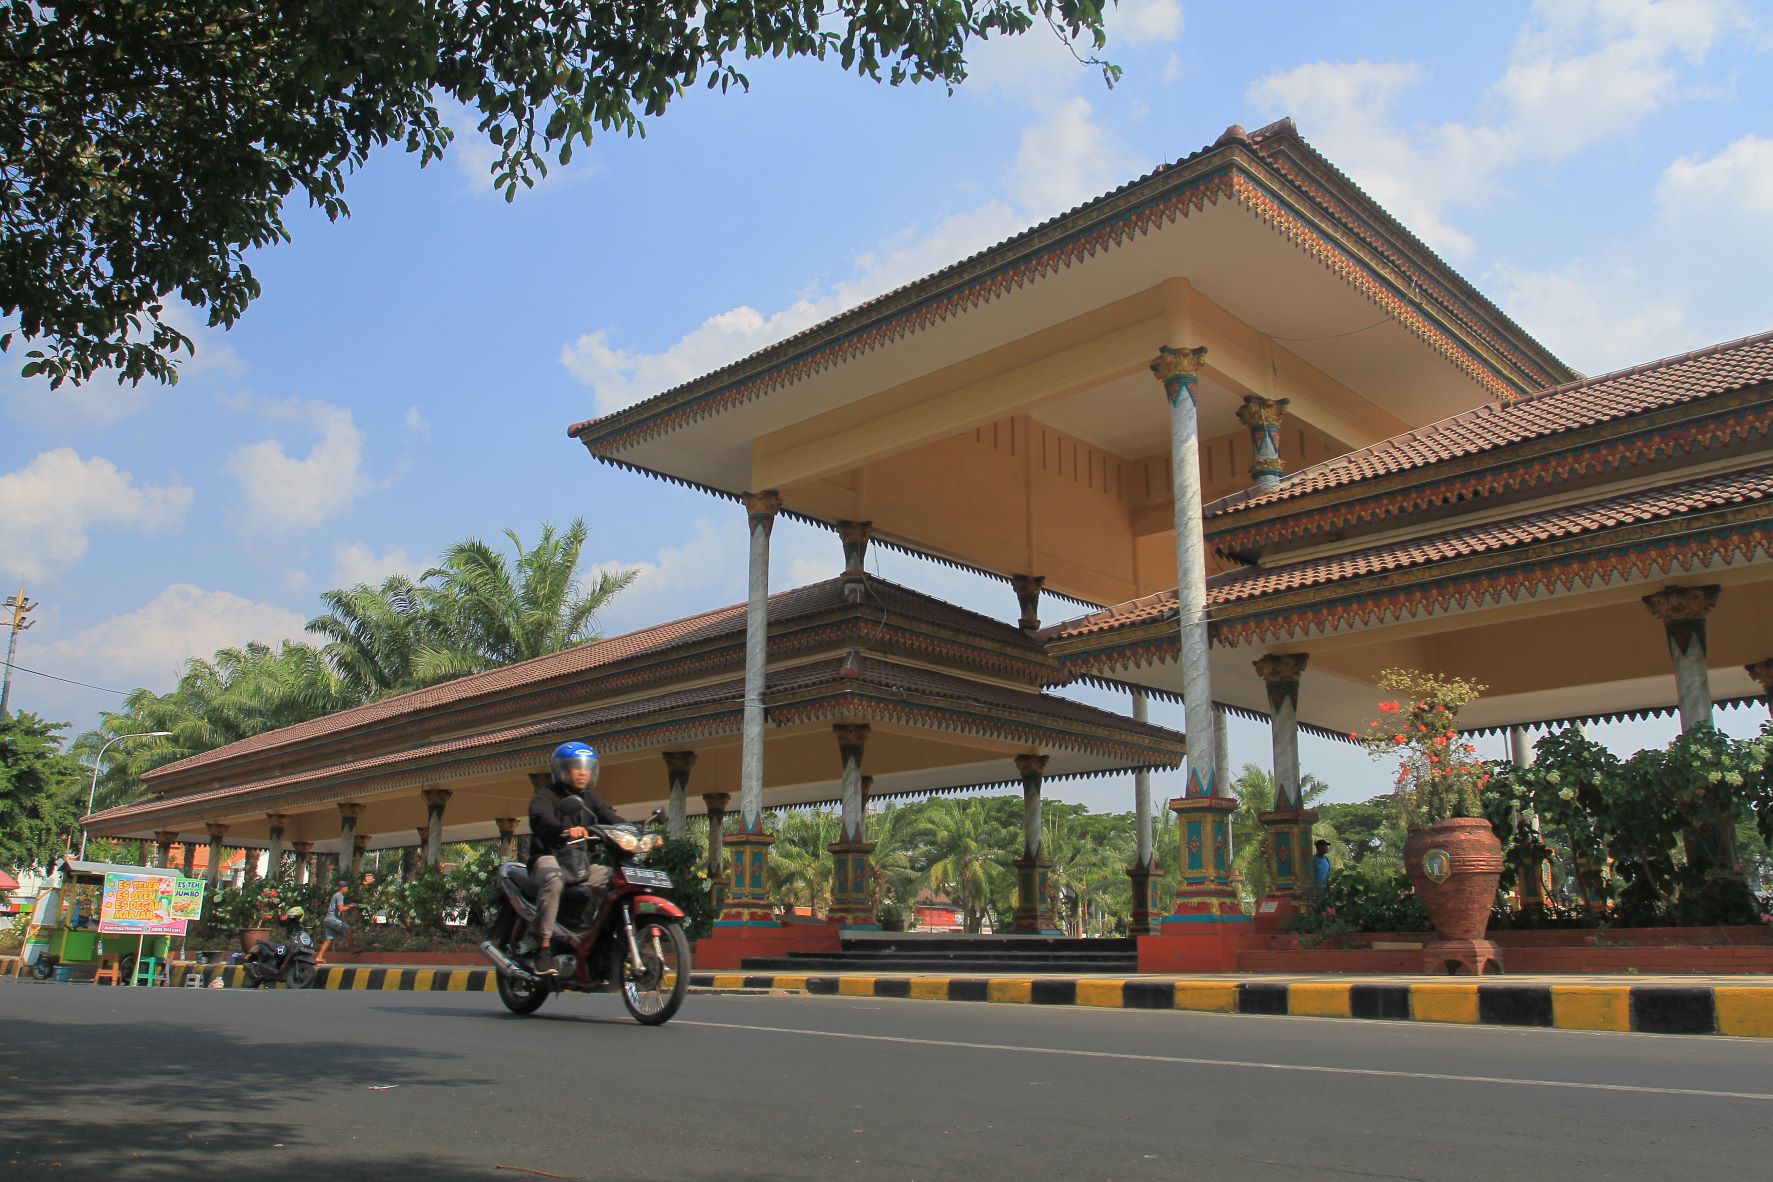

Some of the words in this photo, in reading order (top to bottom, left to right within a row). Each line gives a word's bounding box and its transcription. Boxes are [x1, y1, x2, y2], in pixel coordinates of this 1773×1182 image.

[118, 880, 130, 889] ES
[116, 890, 128, 899] ES
[115, 900, 128, 909] ES
[129, 901, 162, 910] DEGAN
